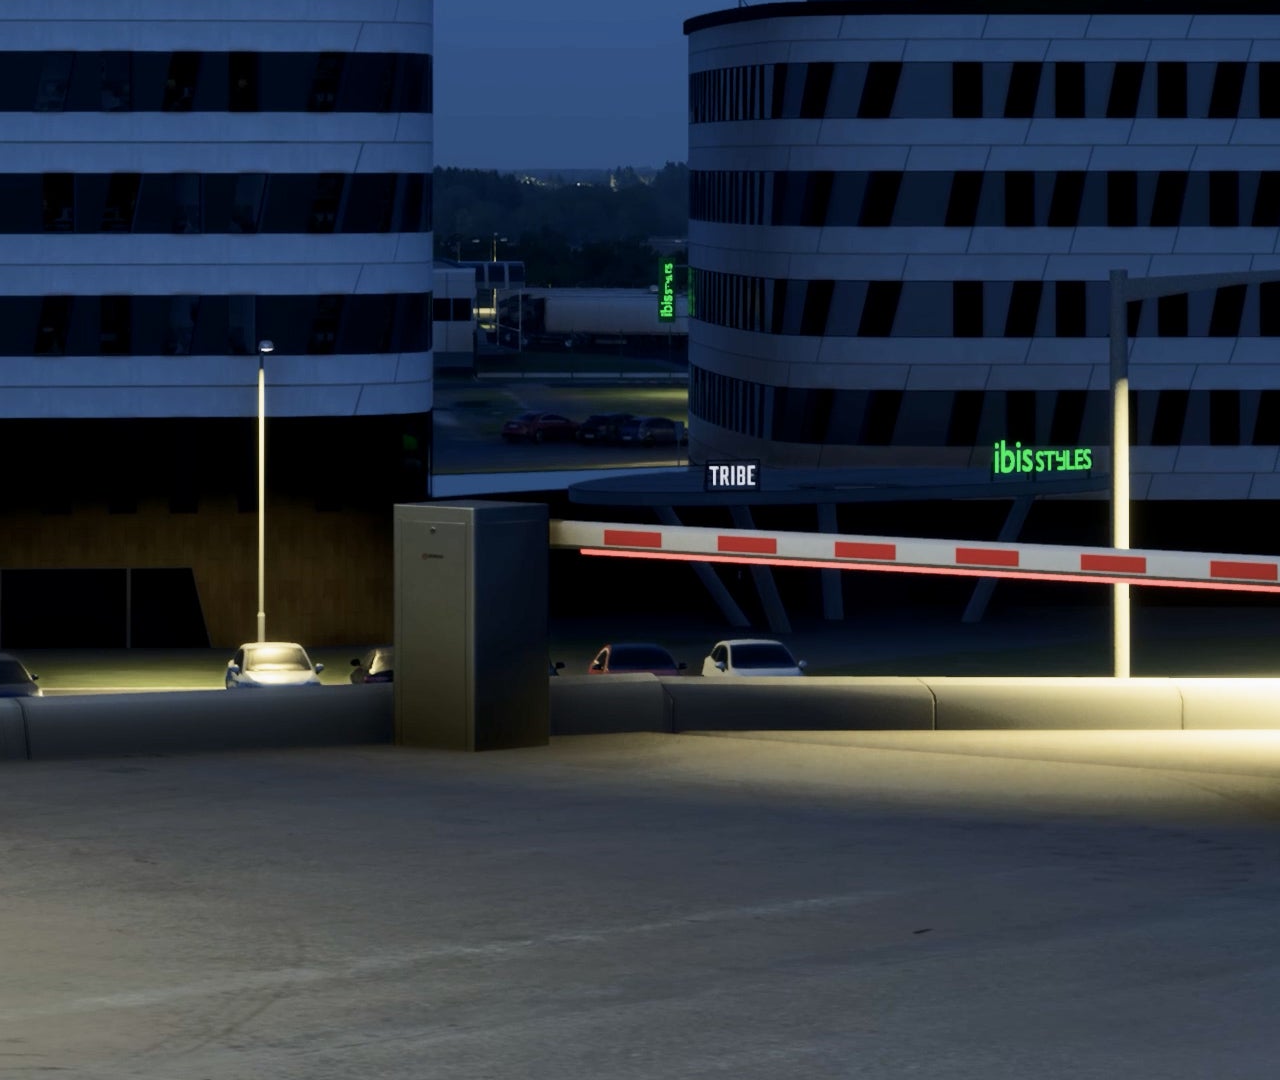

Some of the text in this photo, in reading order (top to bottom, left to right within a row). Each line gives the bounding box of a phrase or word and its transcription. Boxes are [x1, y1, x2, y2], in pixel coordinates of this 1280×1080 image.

[994, 439, 1092, 474] ibis STYLES
[708, 464, 756, 486] TRIBE
